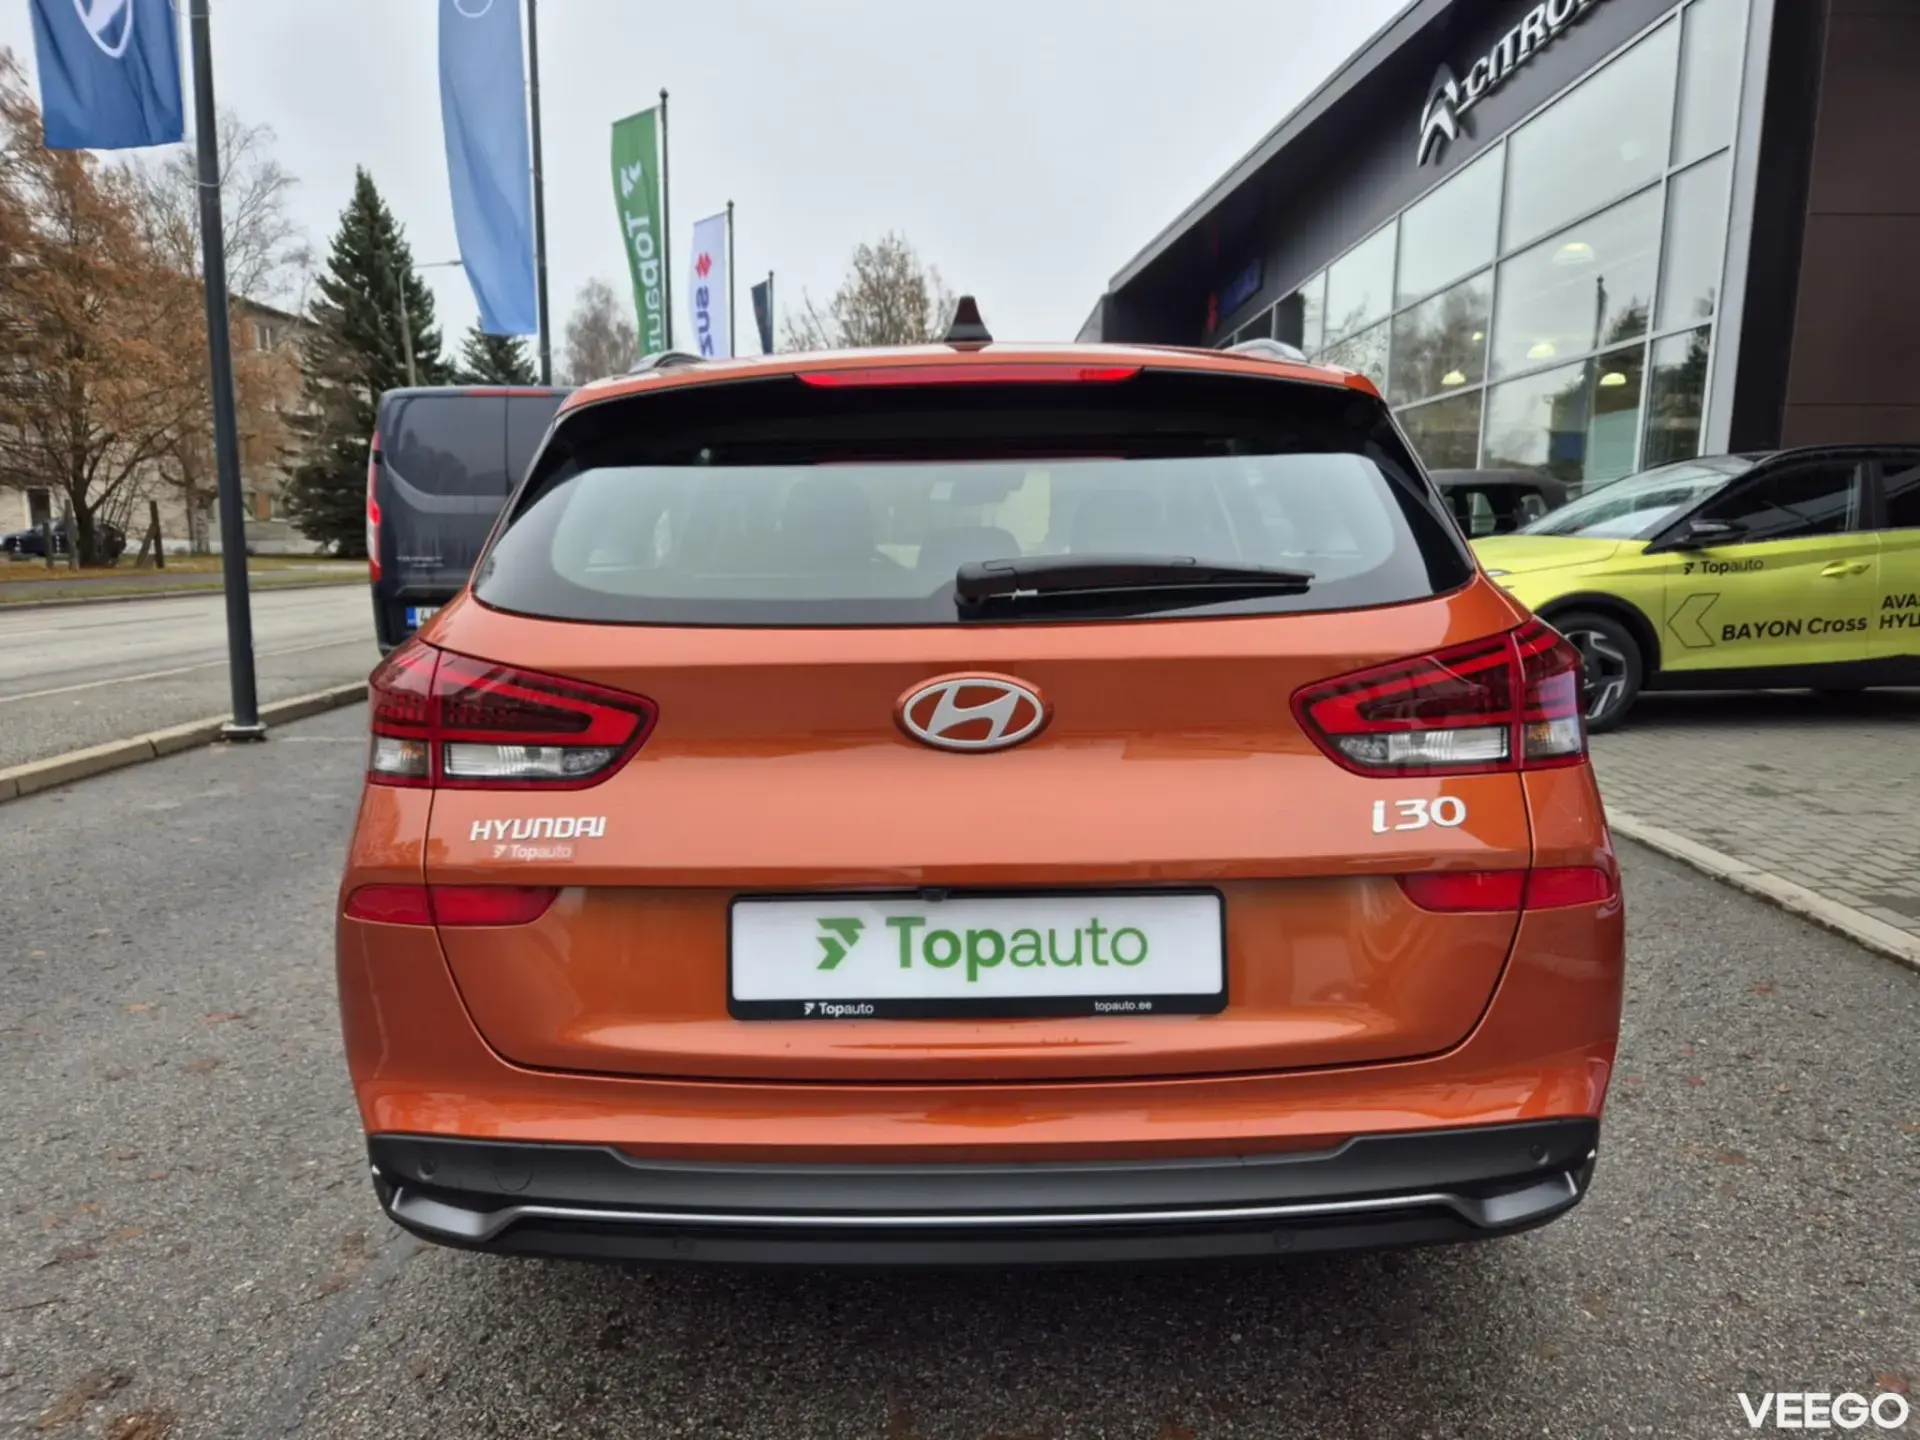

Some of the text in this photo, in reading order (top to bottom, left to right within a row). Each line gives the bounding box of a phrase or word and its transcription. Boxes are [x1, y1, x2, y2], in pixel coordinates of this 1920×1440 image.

[1464, 0, 1586, 97] CITRO
[1700, 559, 1764, 576] Topauto
[1881, 593, 1920, 609] AVA
[1721, 616, 1868, 642] BAYON Cross
[1372, 795, 1466, 833] i30
[470, 816, 606, 841] HYUNDAI
[510, 844, 573, 861] Topauto
[885, 915, 1149, 982] Topauto
[818, 1002, 875, 1017] Topauto
[1094, 1000, 1153, 1012] topauto.ee
